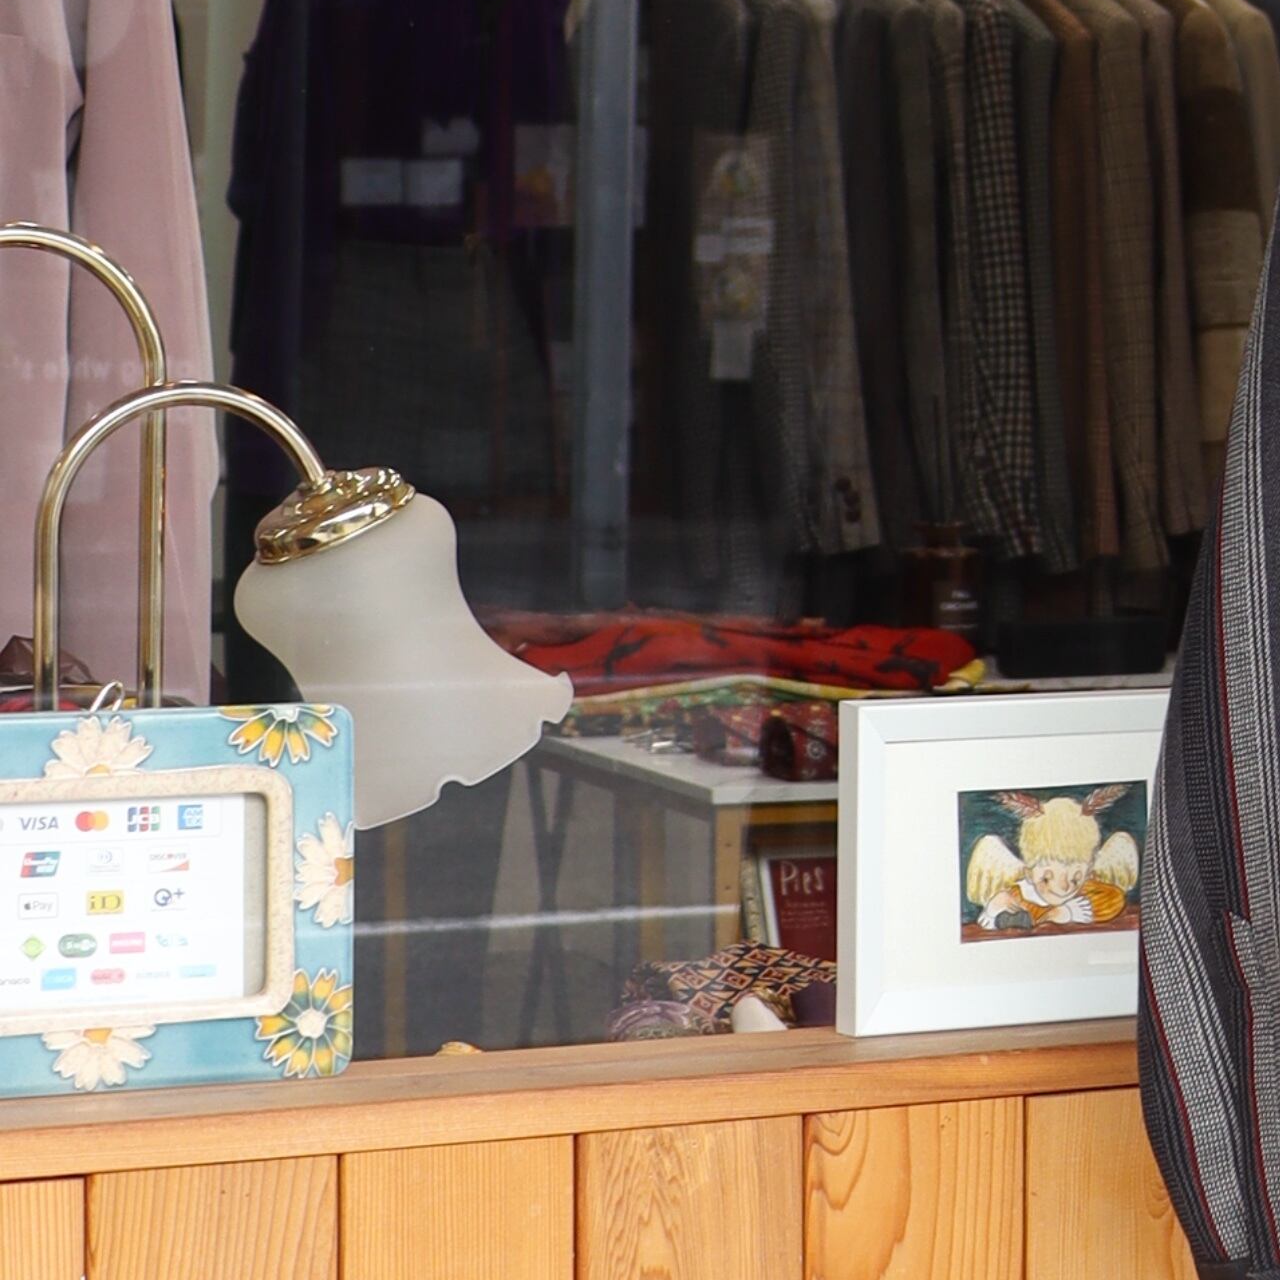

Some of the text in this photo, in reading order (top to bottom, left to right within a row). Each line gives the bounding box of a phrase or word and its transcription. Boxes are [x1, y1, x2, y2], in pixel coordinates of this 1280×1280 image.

[19, 816, 59, 831] VISA
[32, 900, 53, 913] Pay
[89, 894, 122, 911] iD
